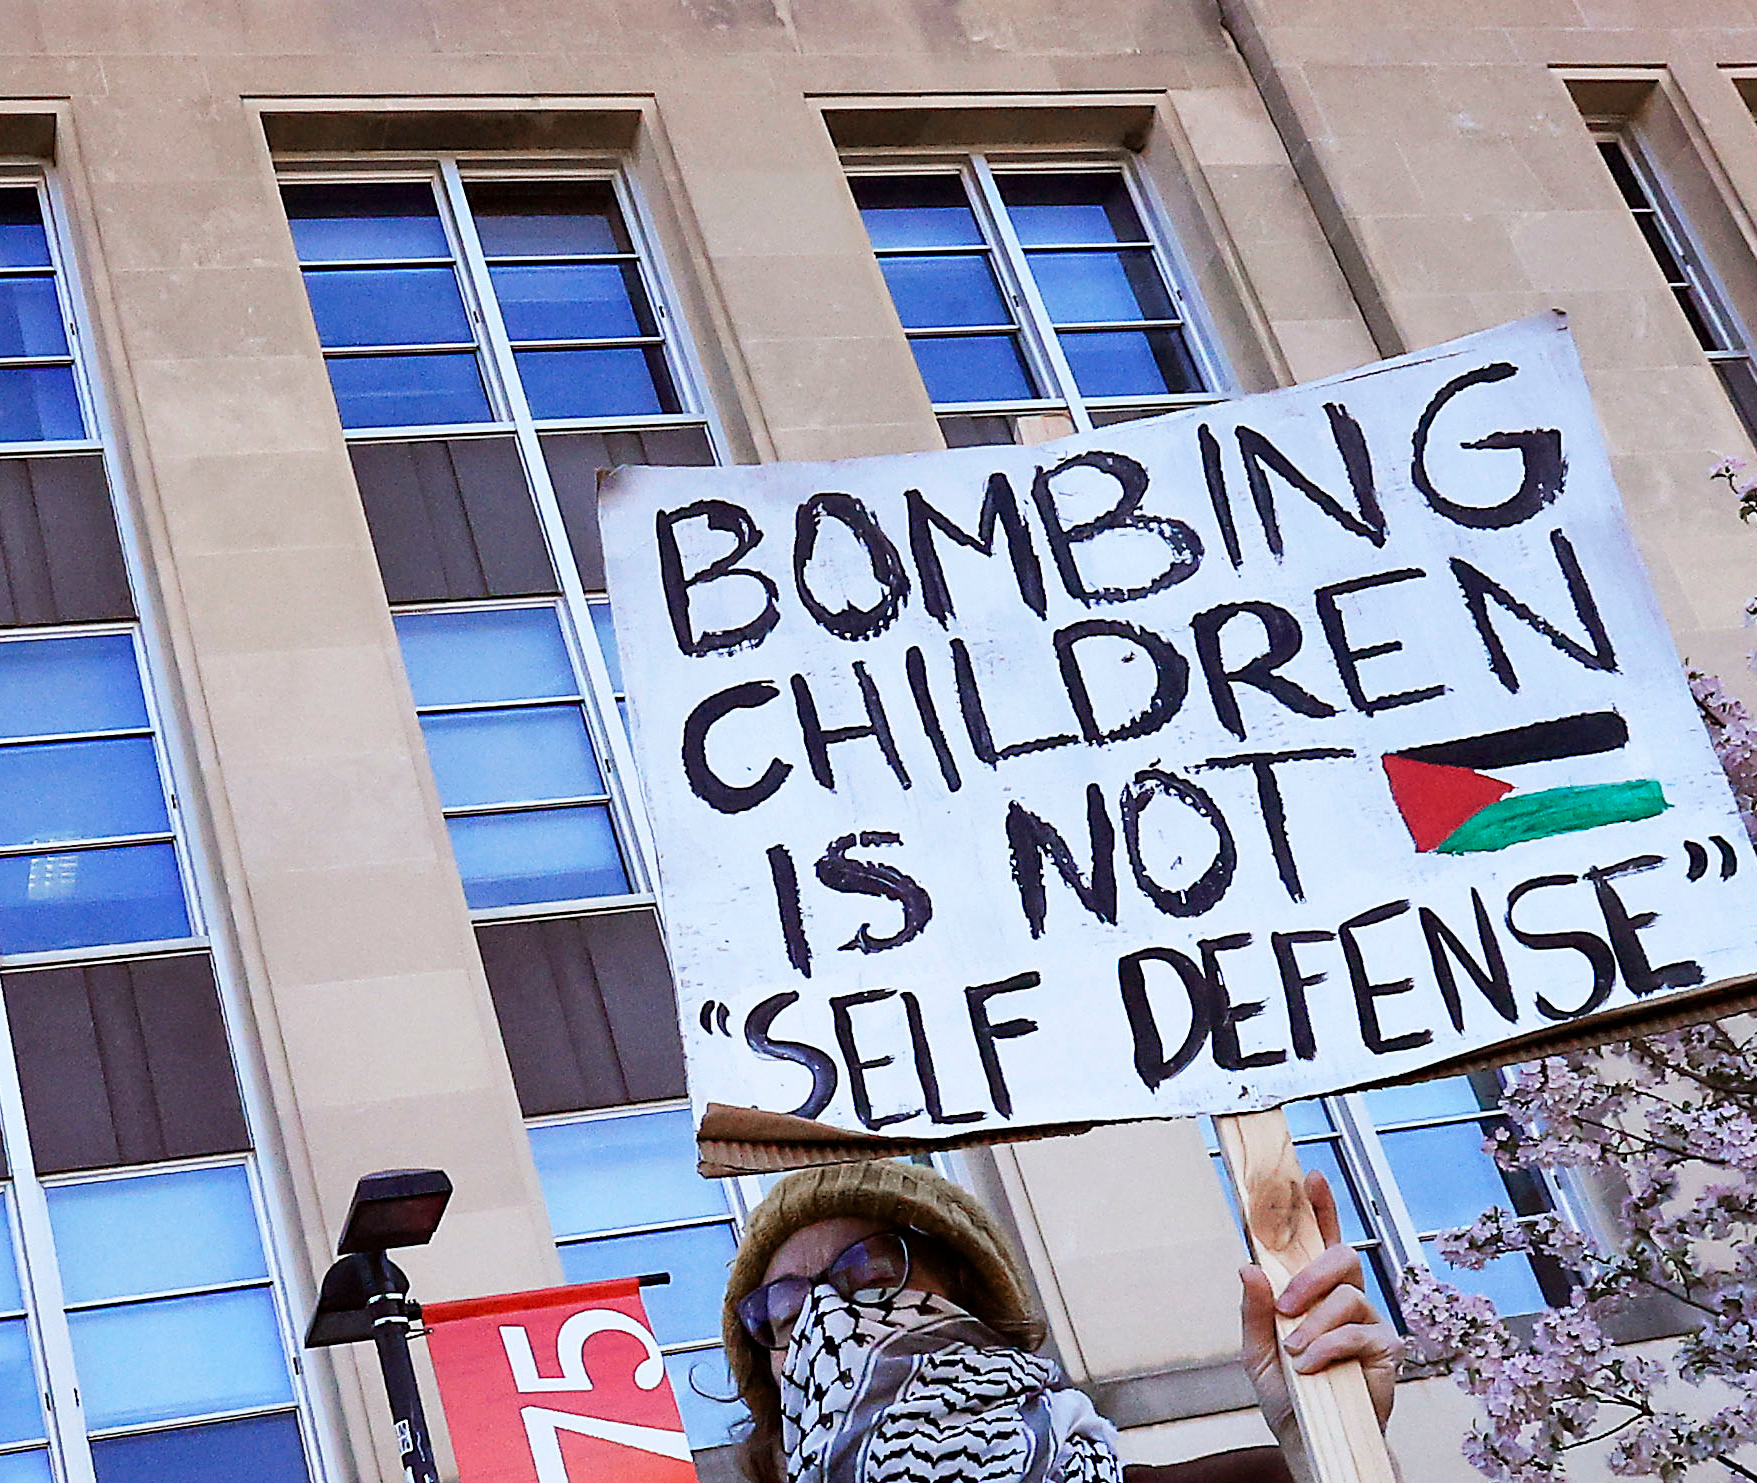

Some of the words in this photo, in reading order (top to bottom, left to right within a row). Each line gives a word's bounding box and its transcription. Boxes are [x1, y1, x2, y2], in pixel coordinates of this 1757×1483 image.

[656, 361, 1568, 658] BOMBING
[682, 527, 1619, 815] CHILDREN
[765, 829, 932, 979] IS
[1005, 747, 1357, 938] NOT
